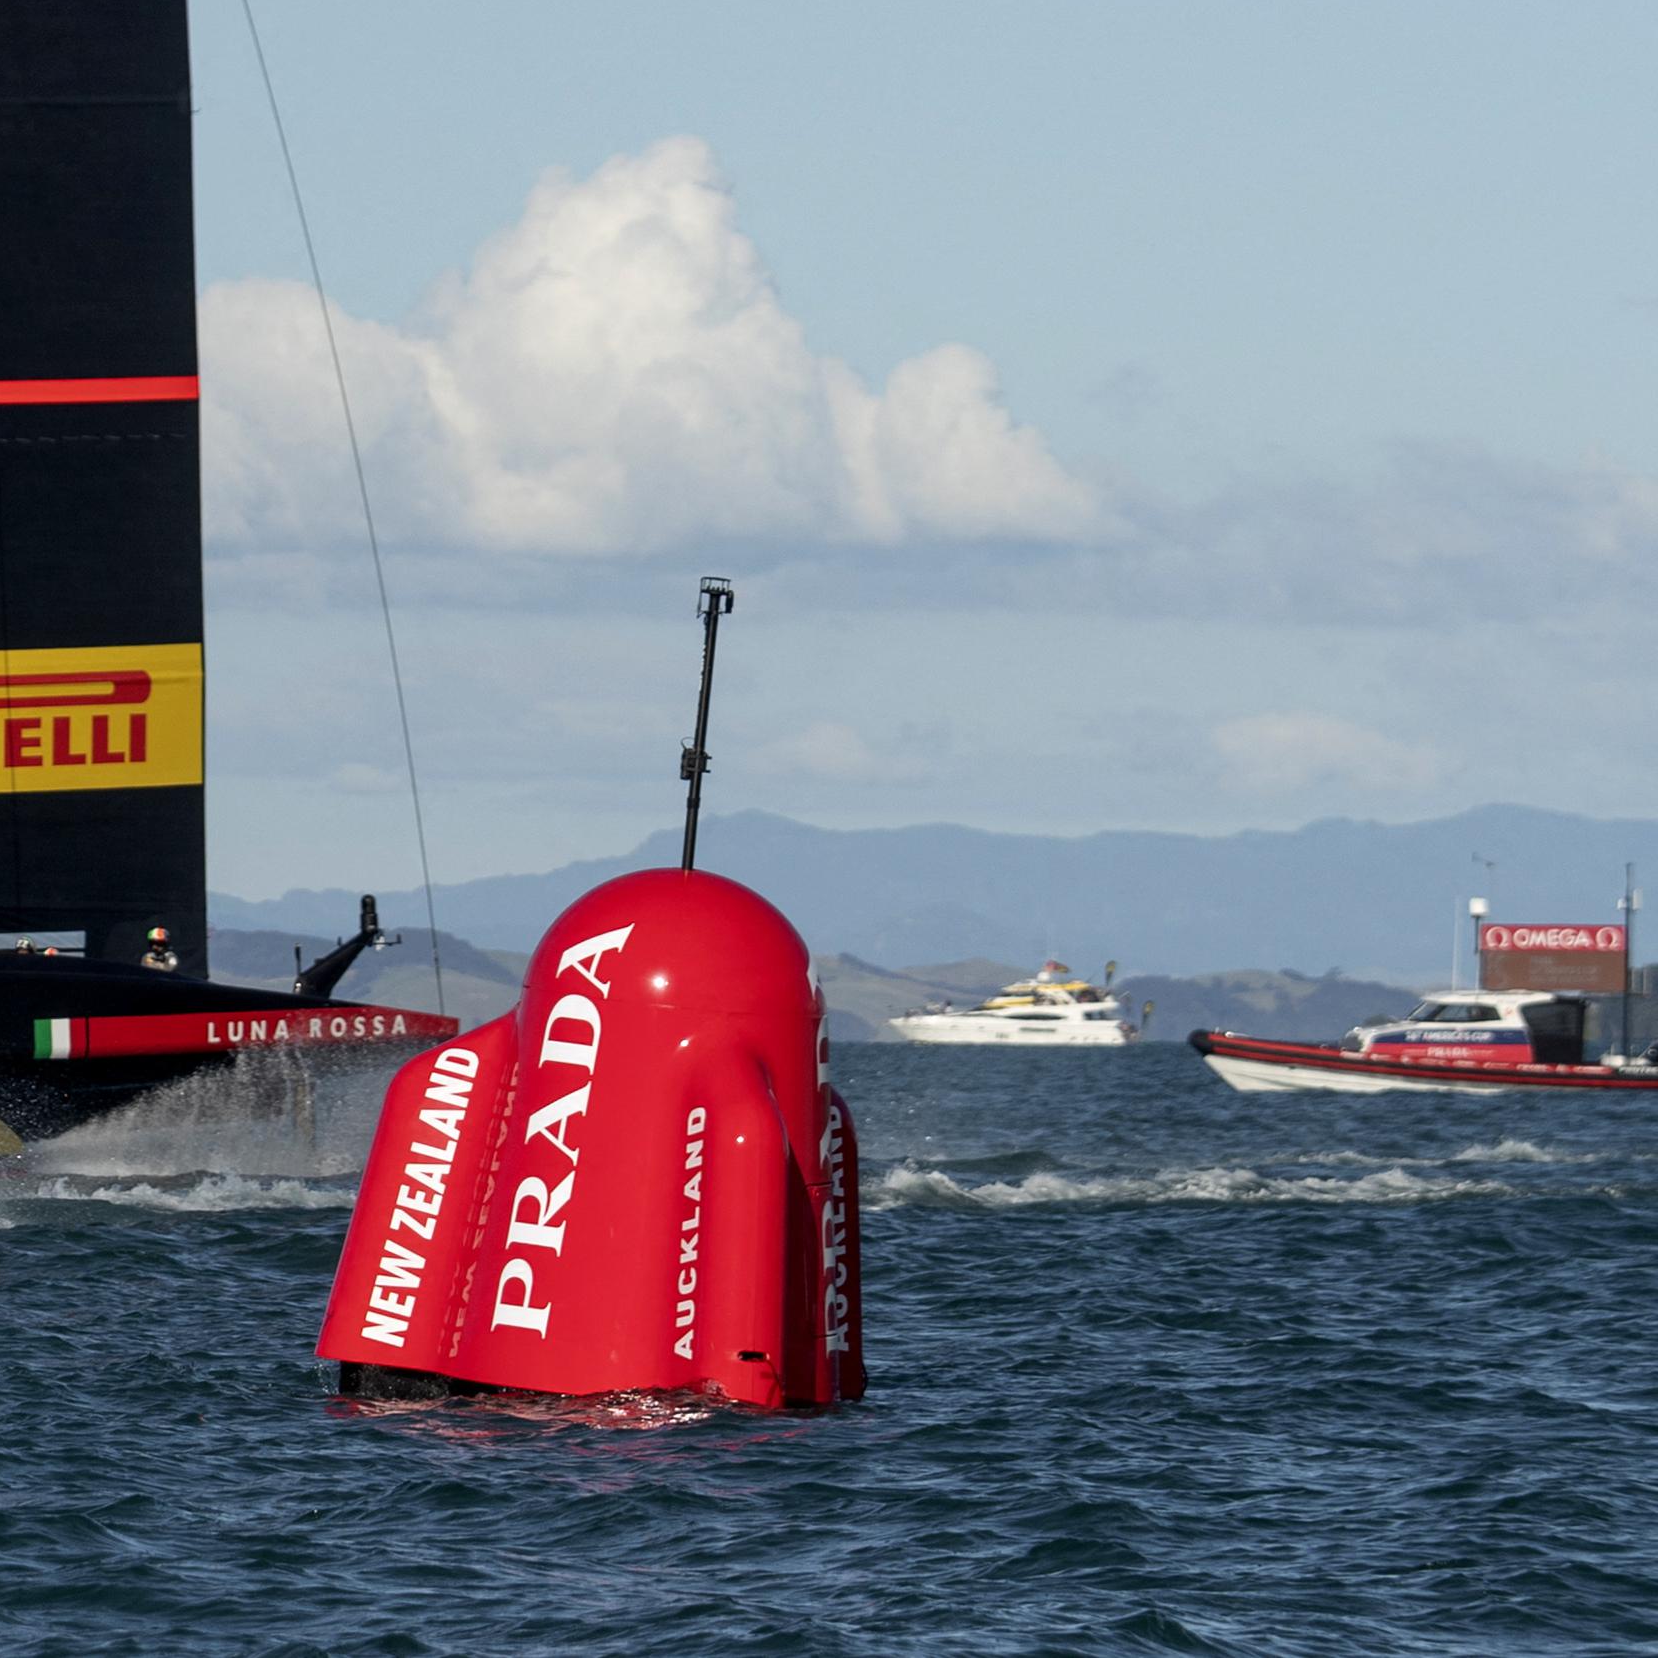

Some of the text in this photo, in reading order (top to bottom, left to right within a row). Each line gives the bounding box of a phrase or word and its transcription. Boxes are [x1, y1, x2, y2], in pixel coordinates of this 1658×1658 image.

[1512, 928, 1592, 950] OMEGA
[207, 1014, 408, 1044] LUNA ROSSA
[391, 1046, 480, 1241] ZEALAND
[490, 923, 635, 1340] PRADA
[362, 1239, 428, 1349] NEW
[673, 1106, 707, 1360] AUCKLAND
